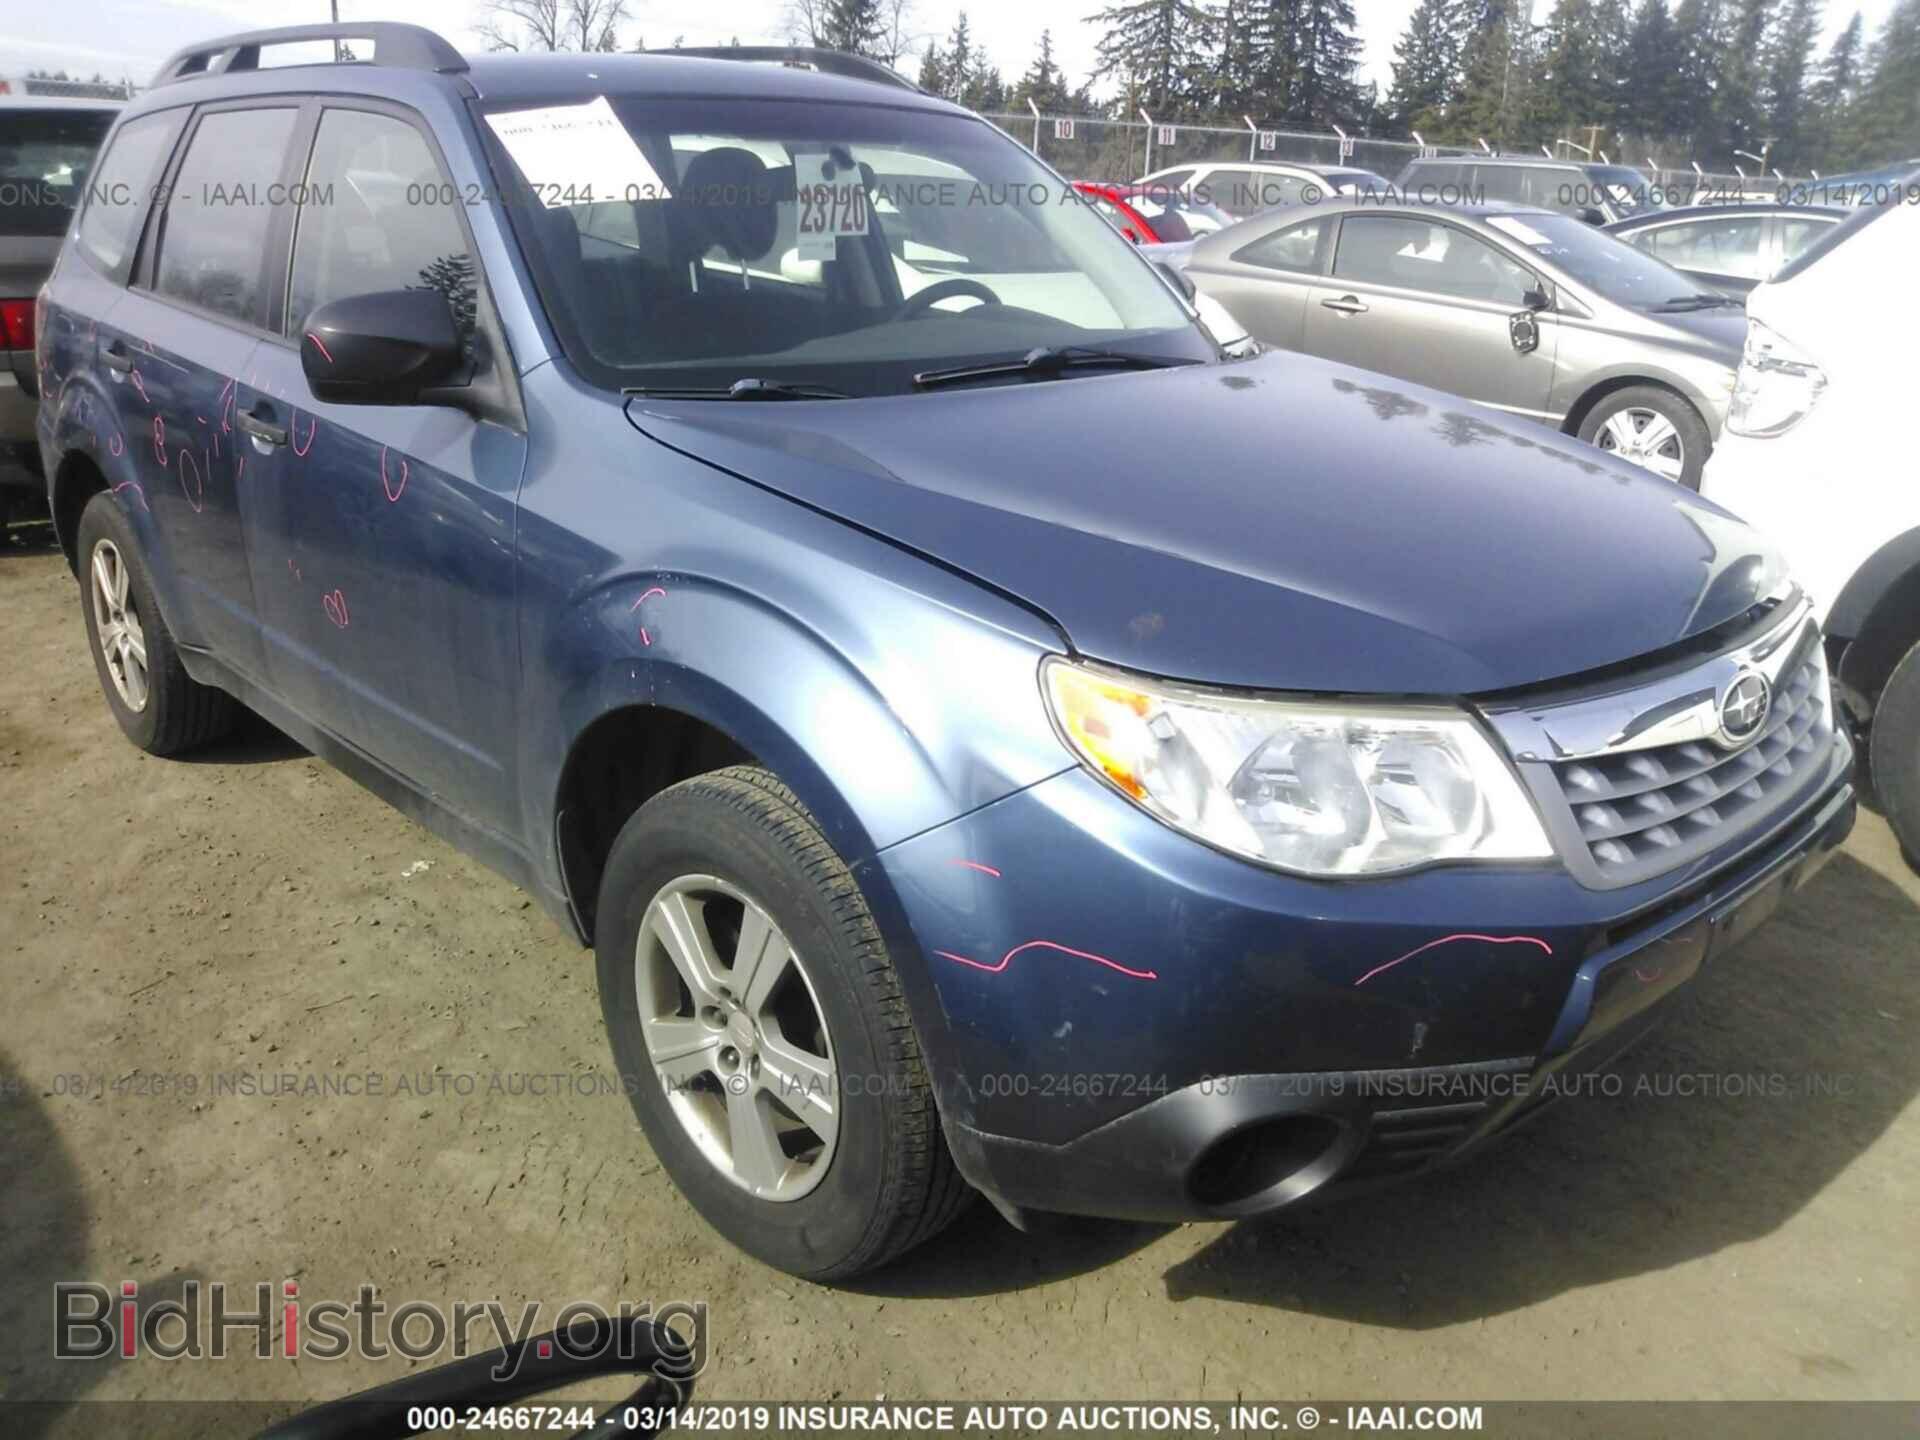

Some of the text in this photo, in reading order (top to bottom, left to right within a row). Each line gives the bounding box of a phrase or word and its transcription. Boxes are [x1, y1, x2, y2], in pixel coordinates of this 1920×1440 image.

[1058, 121, 1072, 138] 10
[1162, 128, 1173, 144] 11
[1262, 134, 1274, 149] 12
